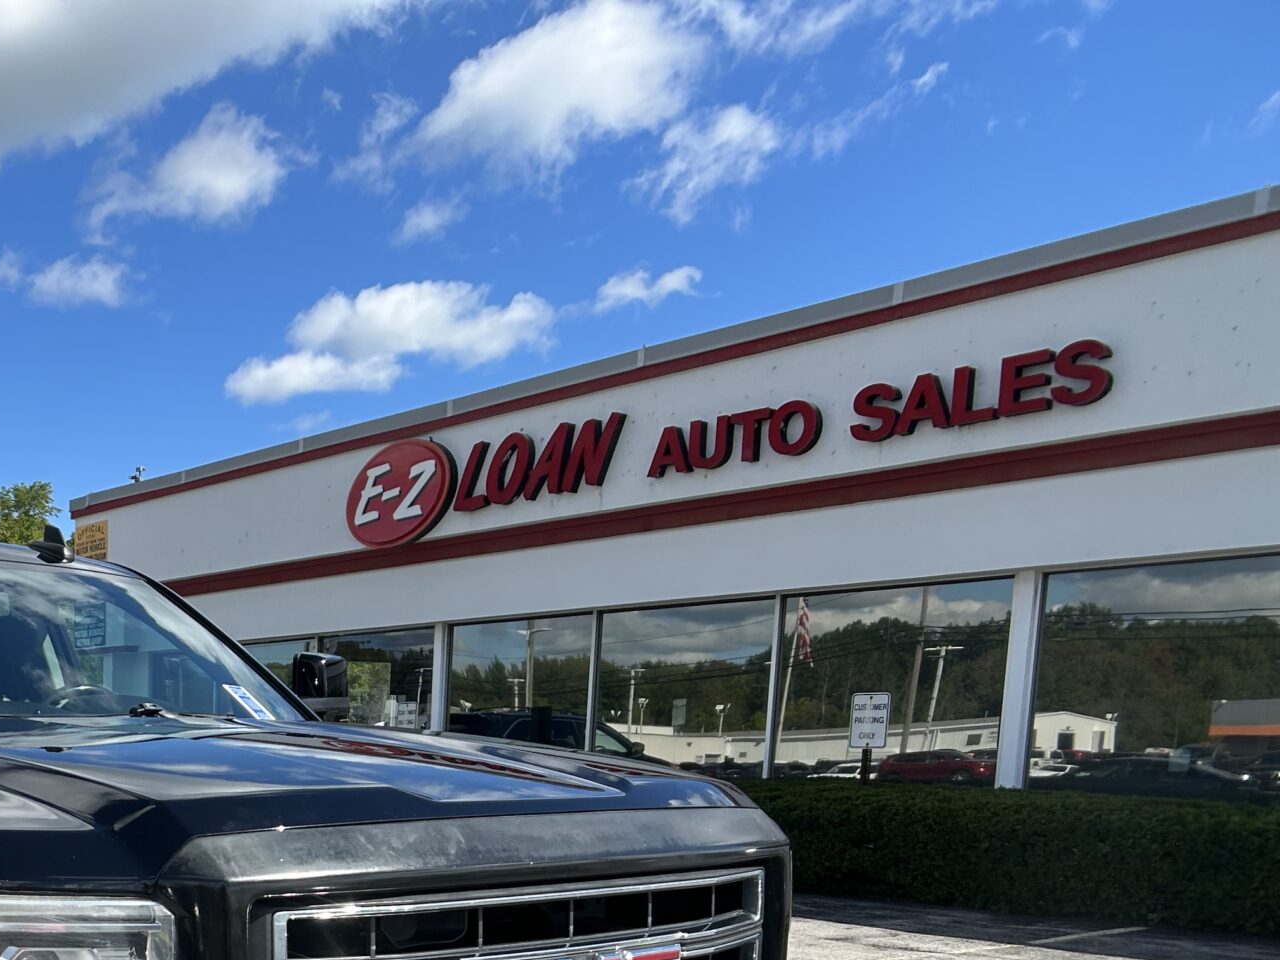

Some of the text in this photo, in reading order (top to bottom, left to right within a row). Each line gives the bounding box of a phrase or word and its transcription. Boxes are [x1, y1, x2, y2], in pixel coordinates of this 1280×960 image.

[354, 339, 1113, 526] E-Z LOAN AUTO SALES
[78, 524, 105, 541] OFFICIAL
[858, 731, 876, 740] ONLY
